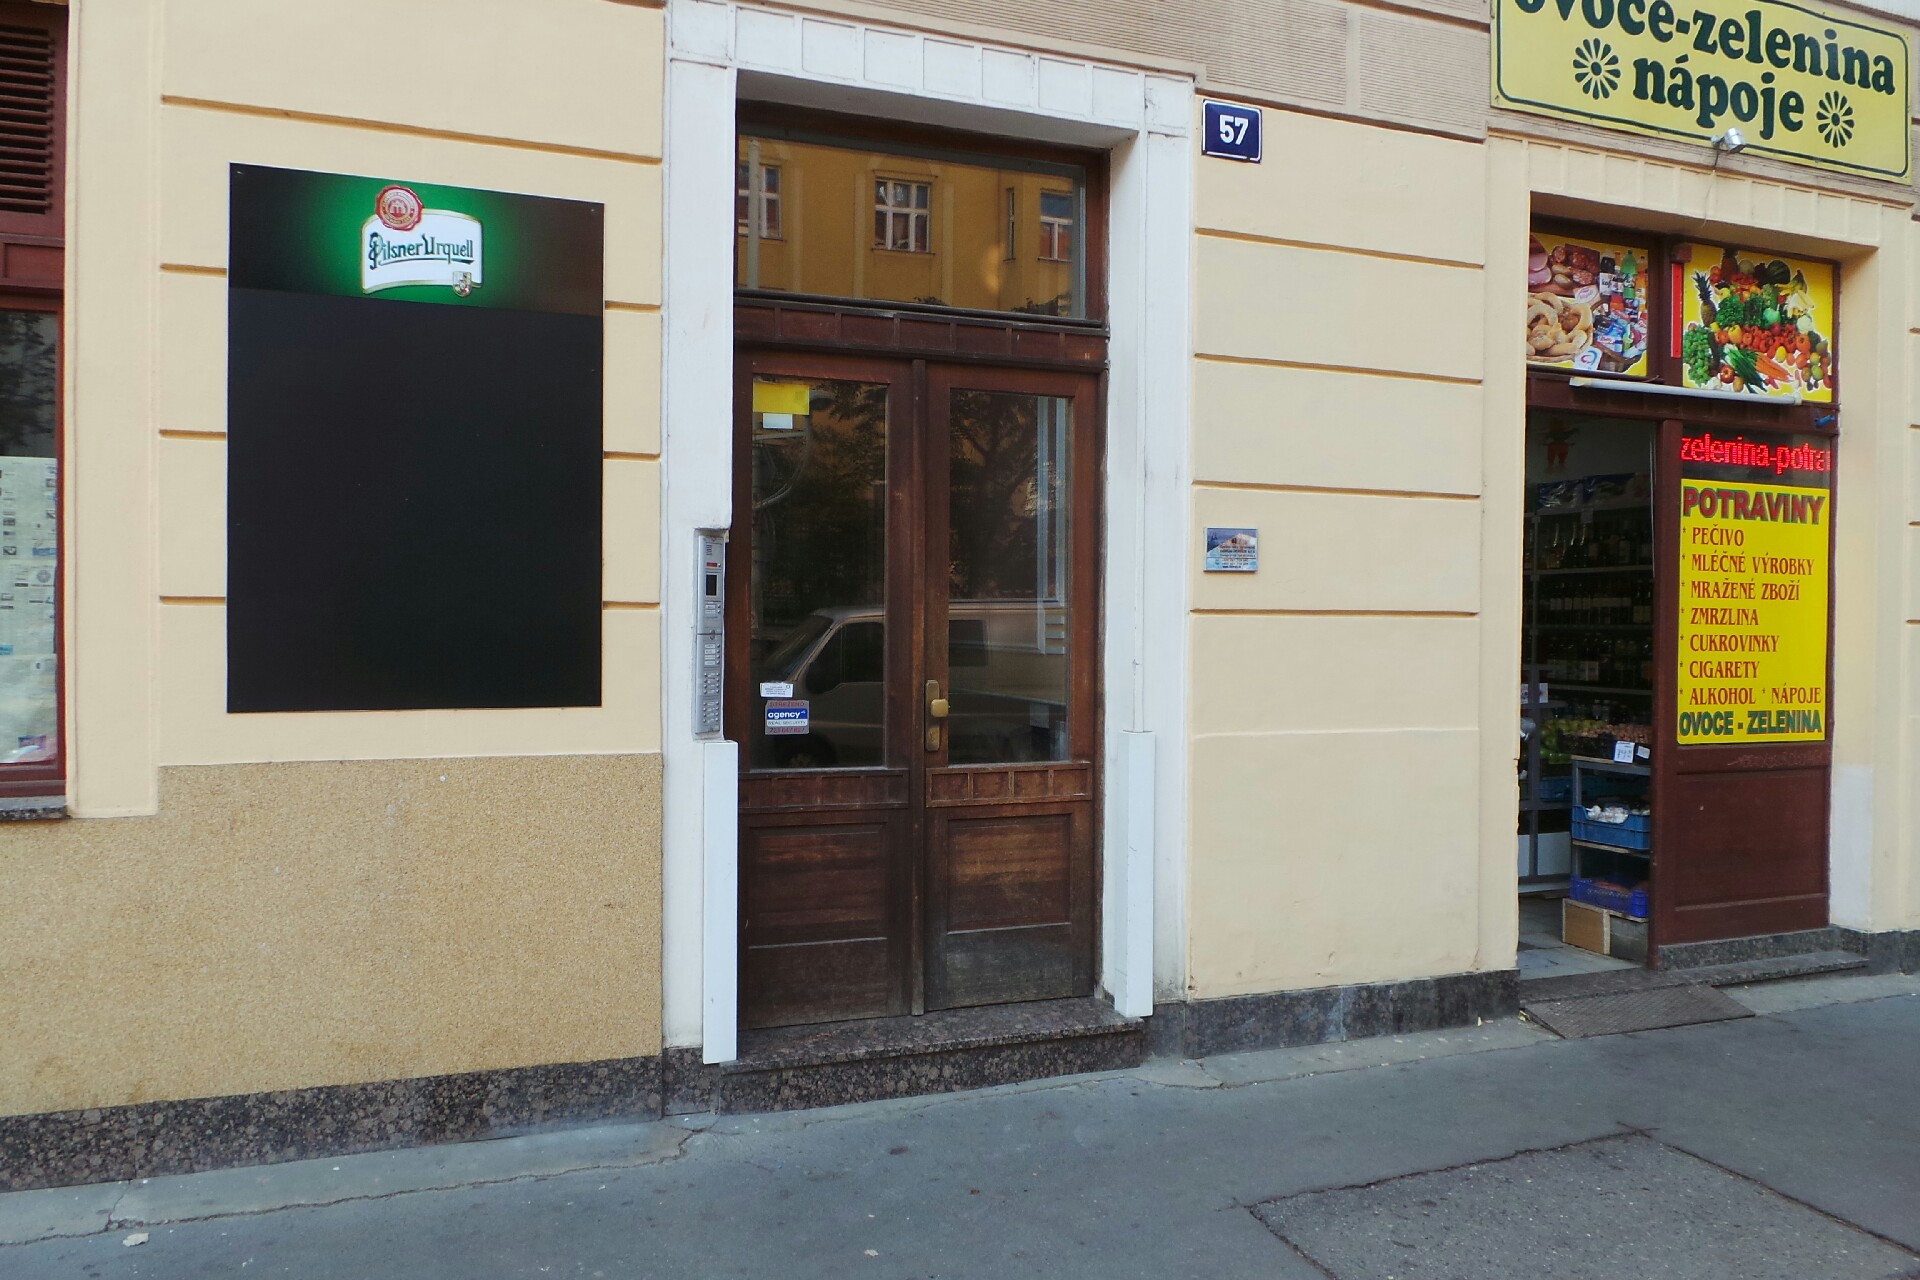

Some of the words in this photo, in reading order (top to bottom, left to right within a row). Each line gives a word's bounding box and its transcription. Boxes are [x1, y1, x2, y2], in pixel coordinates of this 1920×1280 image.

[1632, 53, 1805, 141] nápoje
[1219, 114, 1249, 145] 57
[368, 232, 423, 270] Pilsner
[421, 233, 473, 265] Urquell
[1683, 486, 1825, 524] POTRAVINY
[1692, 523, 1745, 547] PEČIVO
[1691, 550, 1746, 573] MLÉČNÉ
[1752, 552, 1815, 576] VÝROBKY
[1691, 577, 1756, 600] MRAŽENÉ
[1761, 579, 1800, 601] ZBOŽÍ
[1690, 607, 1759, 626] ZMRZLINA
[1689, 634, 1780, 652] CUKROVINKY
[1689, 660, 1760, 678] CIGARETY
[1689, 687, 1756, 705] ALKOHOL
[1771, 682, 1822, 704] NÁPOJE
[768, 712, 800, 720] agency
[1679, 711, 1735, 737] OVOCE
[1746, 710, 1823, 735] ZELENINA
